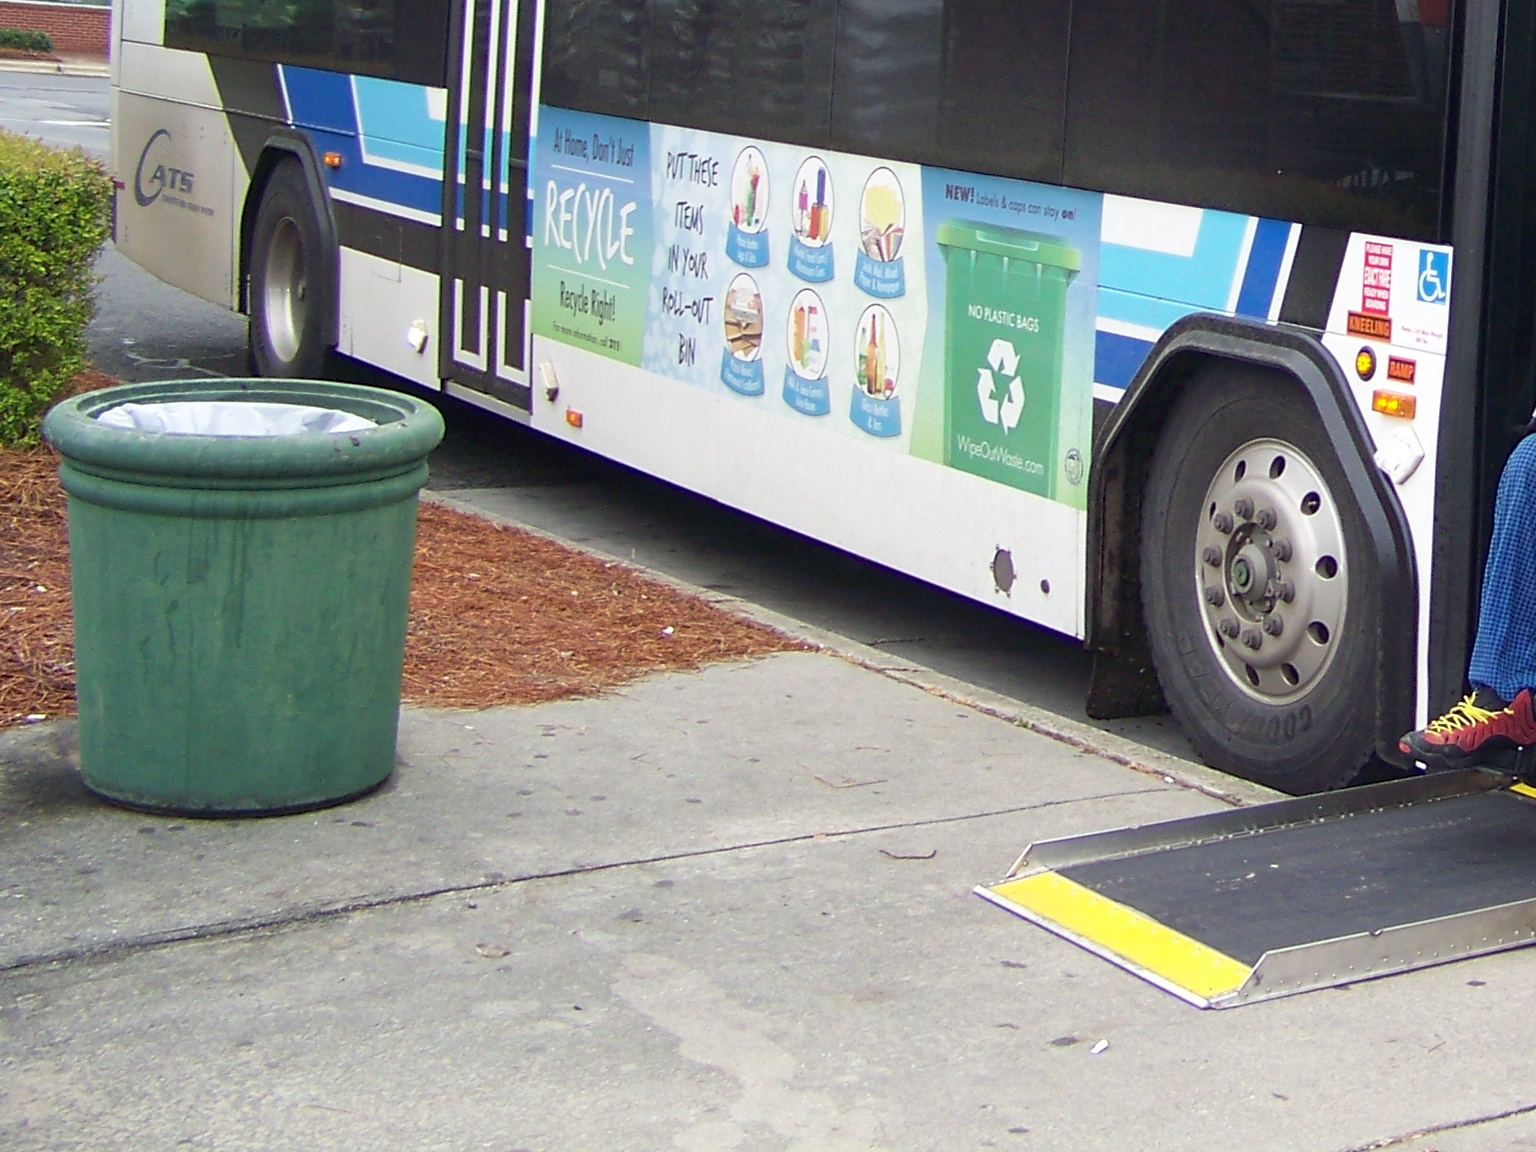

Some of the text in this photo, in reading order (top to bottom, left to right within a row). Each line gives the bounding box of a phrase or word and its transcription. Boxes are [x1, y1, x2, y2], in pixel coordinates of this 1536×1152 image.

[135, 128, 194, 207] CATS
[666, 151, 719, 187] PUT THESE
[945, 183, 975, 203] NEW!
[545, 180, 637, 270] RECYCLE
[675, 201, 704, 235] ITEMS
[668, 244, 680, 273] IN
[682, 248, 708, 279] YOUR
[560, 280, 588, 317] Recycle
[662, 286, 713, 324] ROLL-OUT
[968, 304, 1039, 333] NO PLASTIC BAGS
[1349, 315, 1390, 337] KNEELING
[678, 333, 697, 366] BIN
[1389, 360, 1414, 379] RAMP
